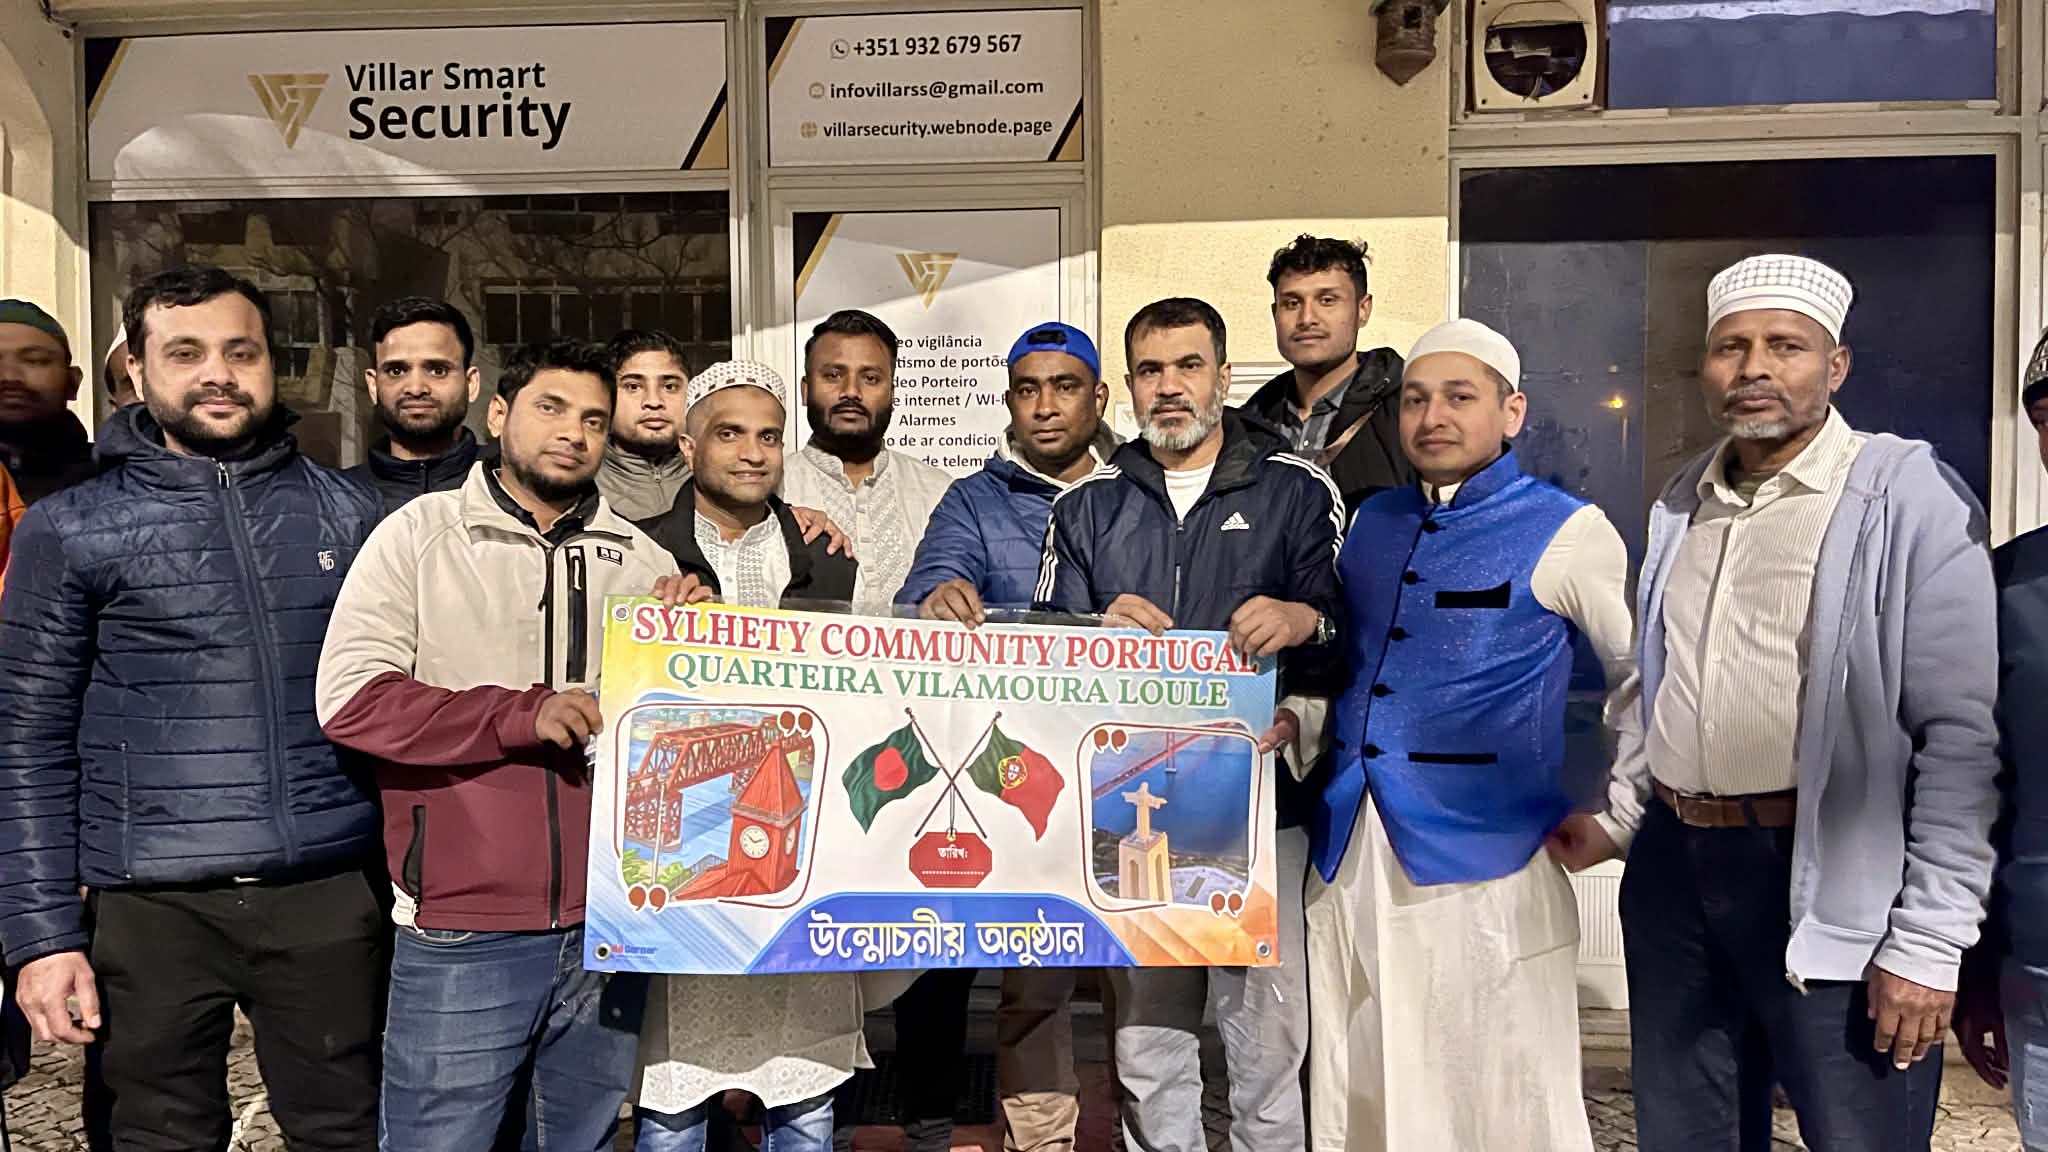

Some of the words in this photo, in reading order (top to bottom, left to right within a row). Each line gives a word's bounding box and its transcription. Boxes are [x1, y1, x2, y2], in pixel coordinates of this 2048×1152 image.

[854, 37, 899, 56] +351
[905, 36, 940, 55] 932
[946, 35, 981, 54] 679
[987, 34, 1022, 53] 567
[345, 62, 434, 92] Villar
[443, 61, 546, 90] Smart
[830, 79, 1044, 99] infovillarss@gmail.com
[348, 91, 572, 150] Security
[823, 118, 1053, 139] villarsecurity.webnode.page
[917, 335, 982, 351] vigilância
[940, 355, 957, 368] de
[961, 355, 1008, 370] portõe
[921, 376, 978, 388] Porteiro
[904, 395, 961, 407] internet
[898, 413, 956, 427] Alarmes
[899, 434, 917, 447] de
[920, 437, 935, 447] ar
[938, 433, 1000, 447] condicio
[943, 455, 983, 467] telem
[635, 606, 810, 653] SYLHETY
[820, 623, 1057, 667] COMMUNITY
[667, 653, 882, 694] QUARTEIRA
[893, 669, 1109, 704] VILAMOURA
[1118, 679, 1228, 707] LOULE
[975, 907, 1085, 967] অনুষ্ঠান
